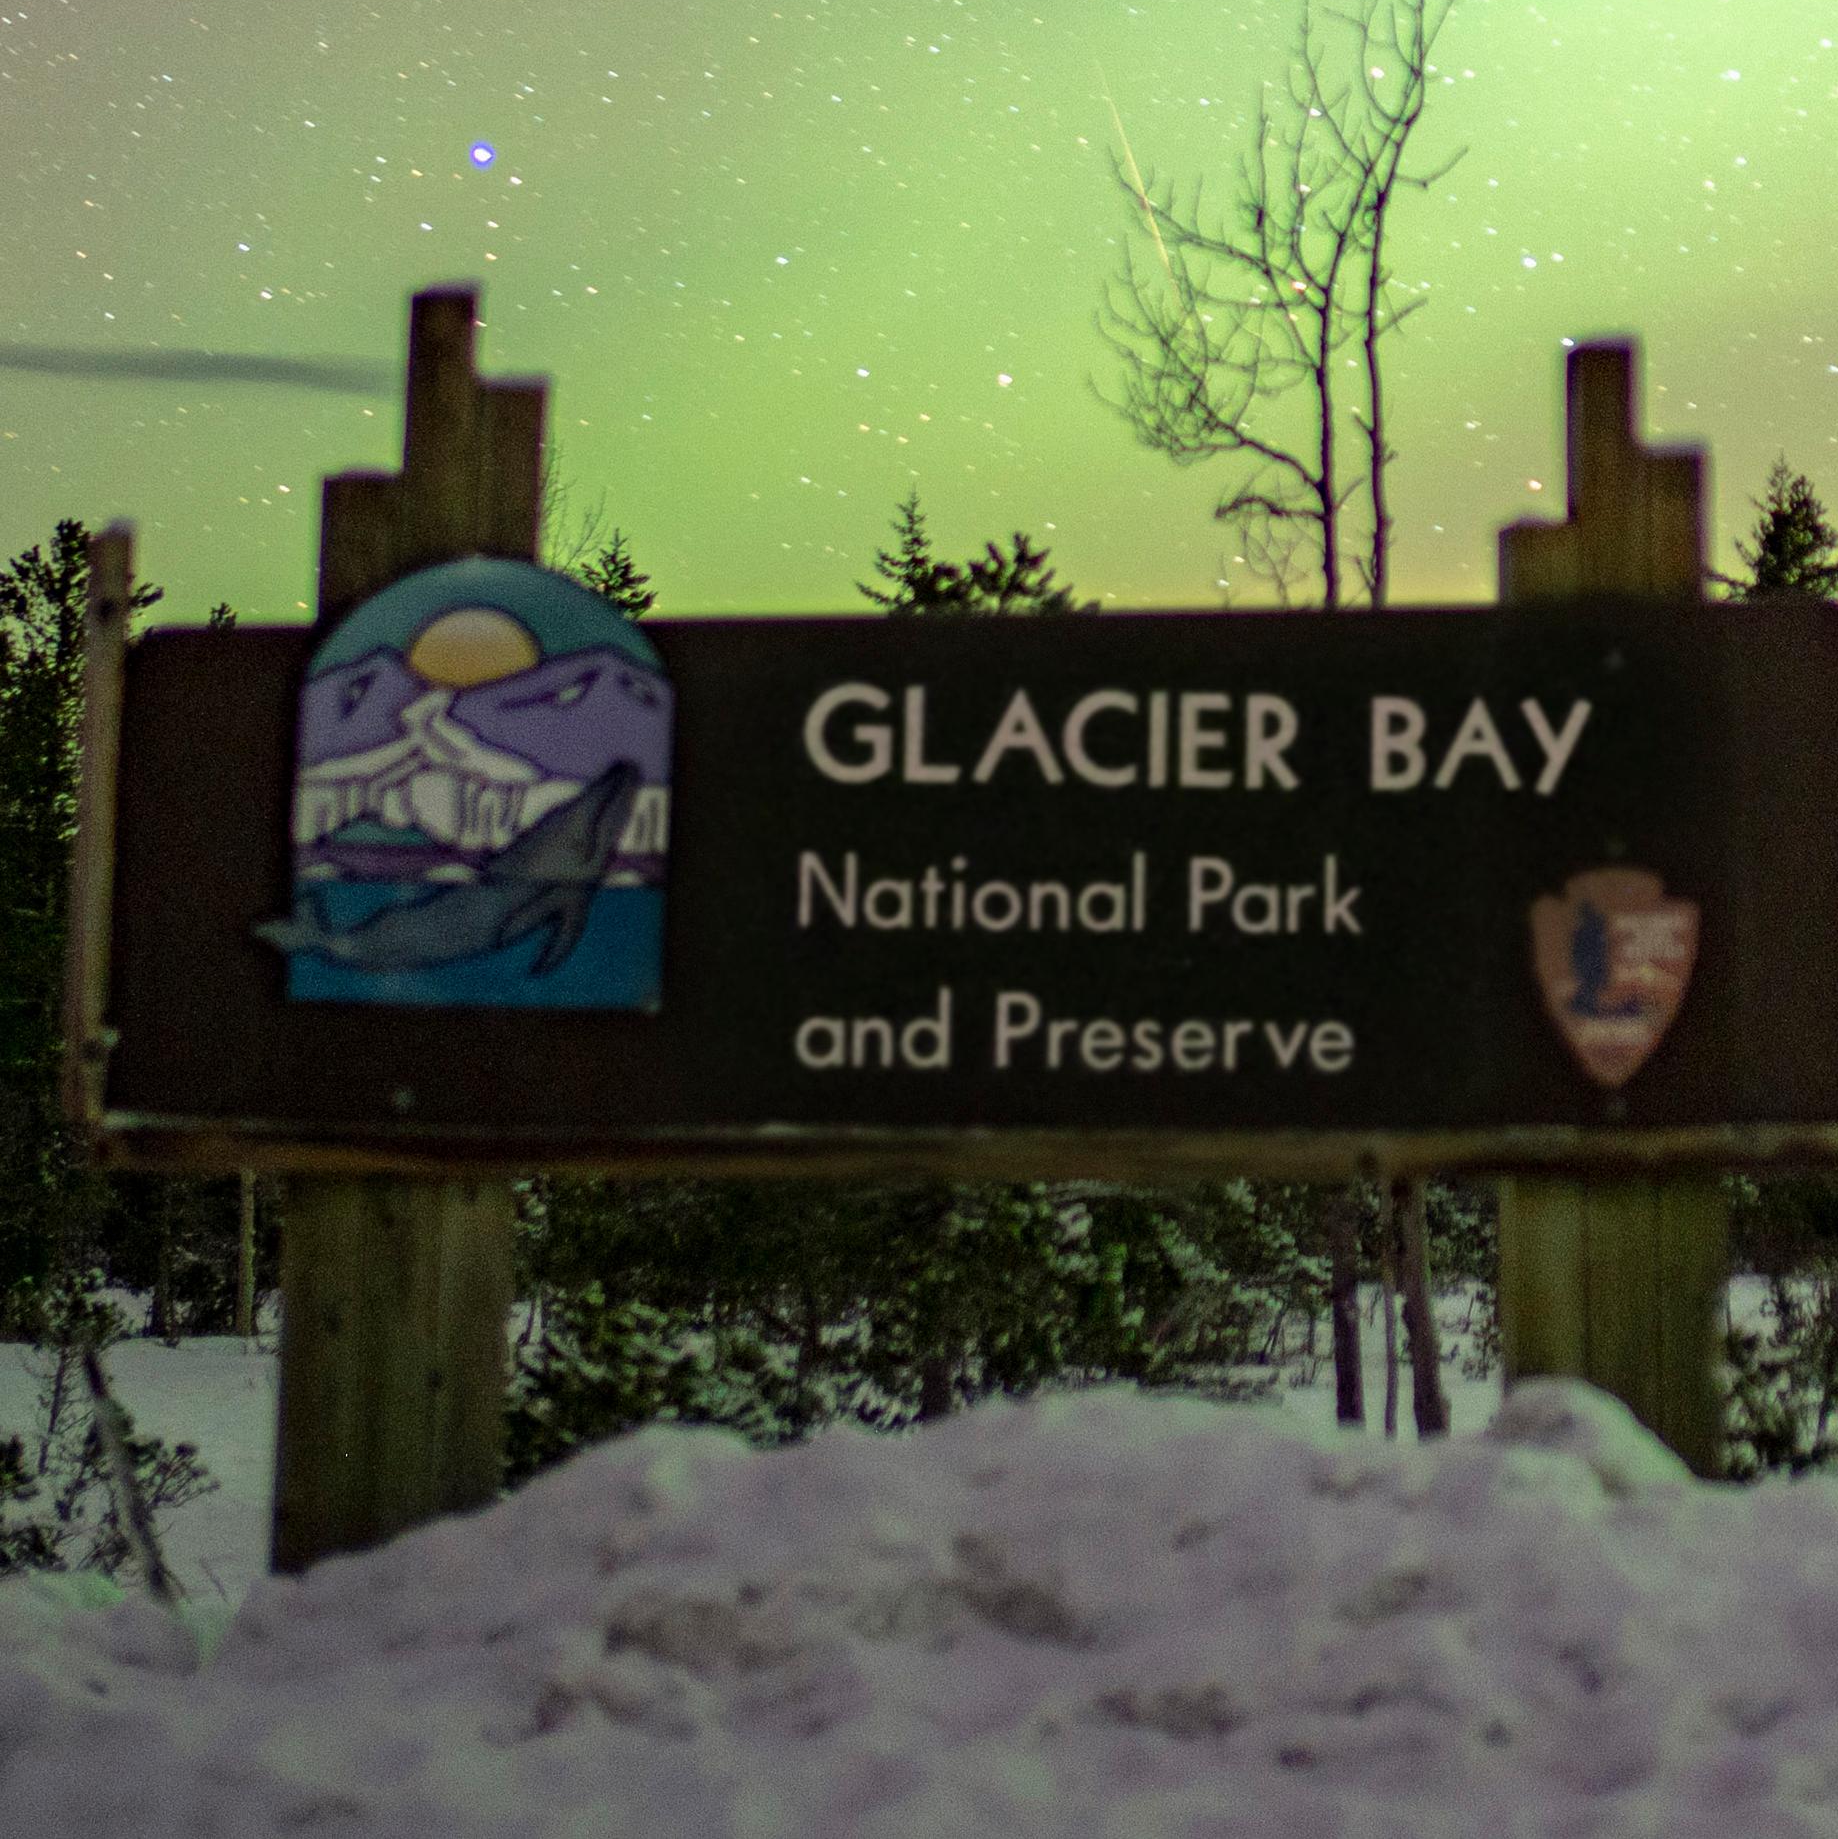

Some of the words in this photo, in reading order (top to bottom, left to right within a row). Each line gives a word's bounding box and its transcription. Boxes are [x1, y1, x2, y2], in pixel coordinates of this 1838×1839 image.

[803, 682, 1299, 790] GLACIER
[1370, 695, 1592, 795] BAY
[797, 850, 1147, 933] National
[1188, 854, 1361, 935] Park
[794, 986, 952, 1069] and
[994, 990, 1355, 1073] Preserve
